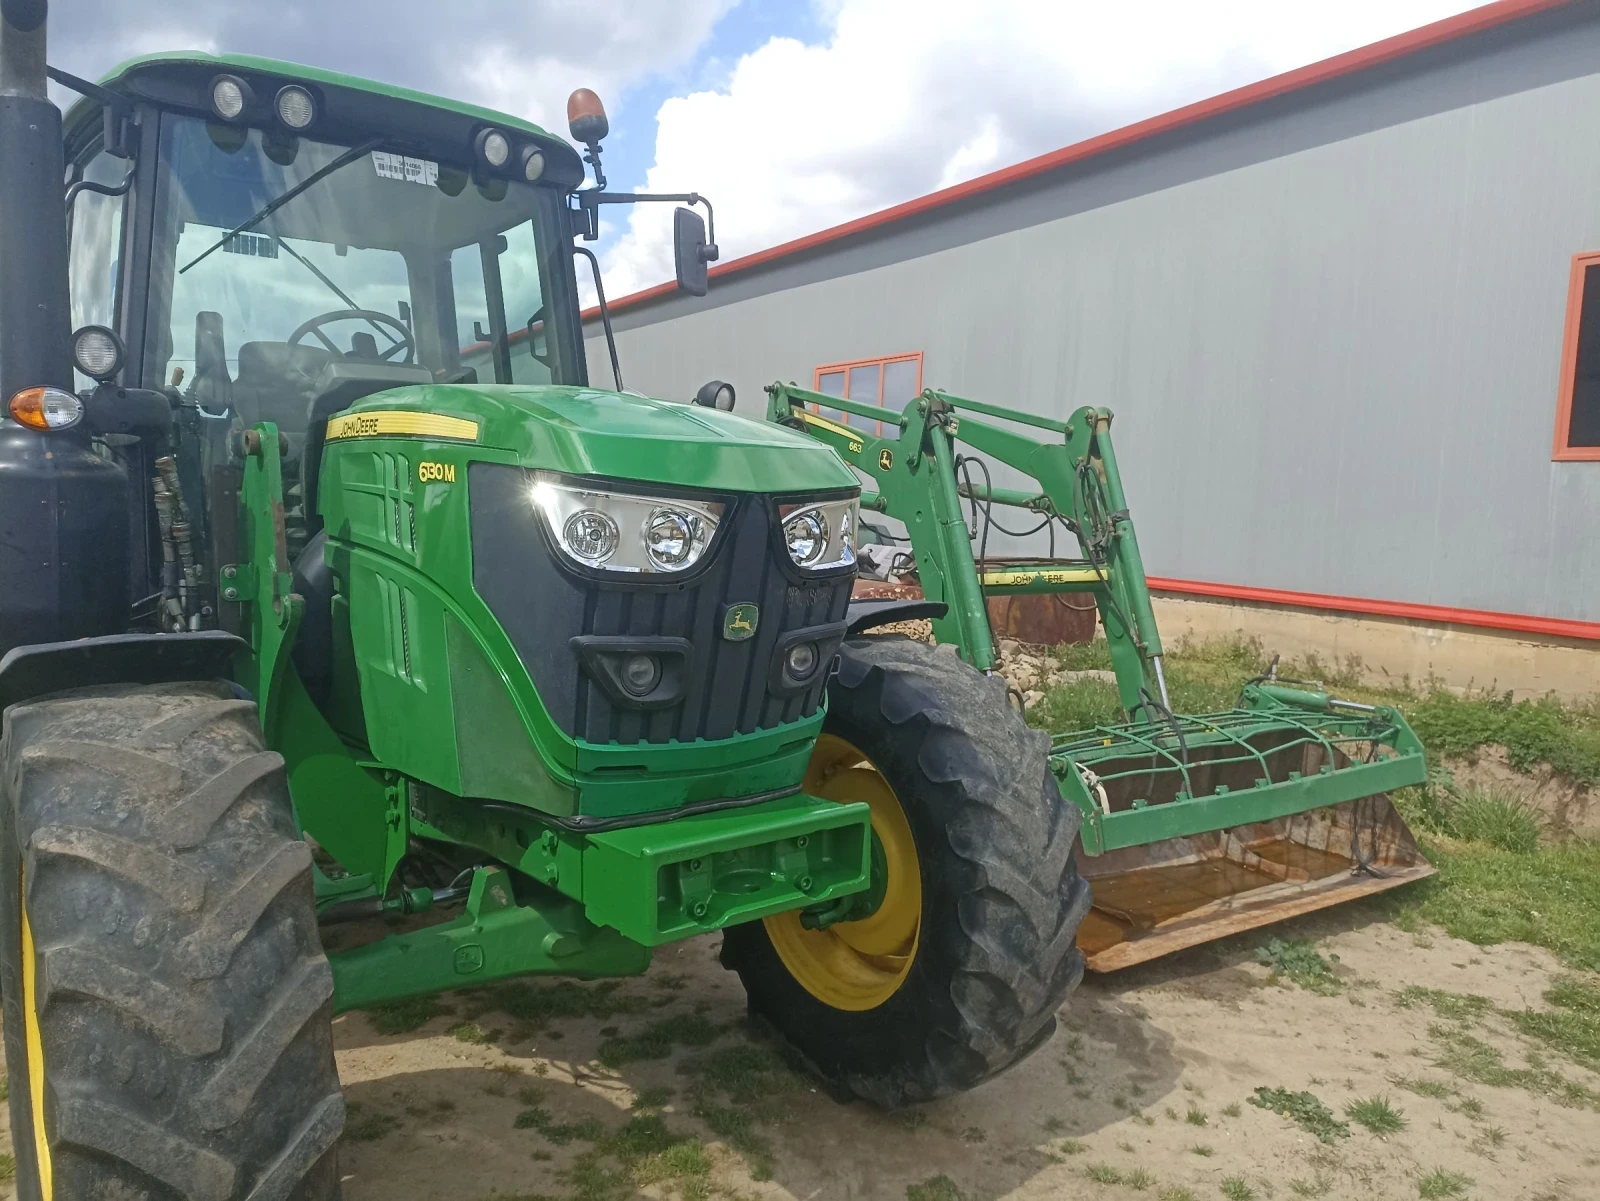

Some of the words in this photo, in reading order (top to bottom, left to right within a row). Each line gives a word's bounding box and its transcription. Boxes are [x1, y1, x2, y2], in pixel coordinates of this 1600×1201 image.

[340, 420, 356, 437] JOHN
[355, 417, 379, 435] DEERE
[848, 441, 862, 453] 663
[1011, 574, 1033, 584] JOHN
[1040, 574, 1064, 583] EERE
